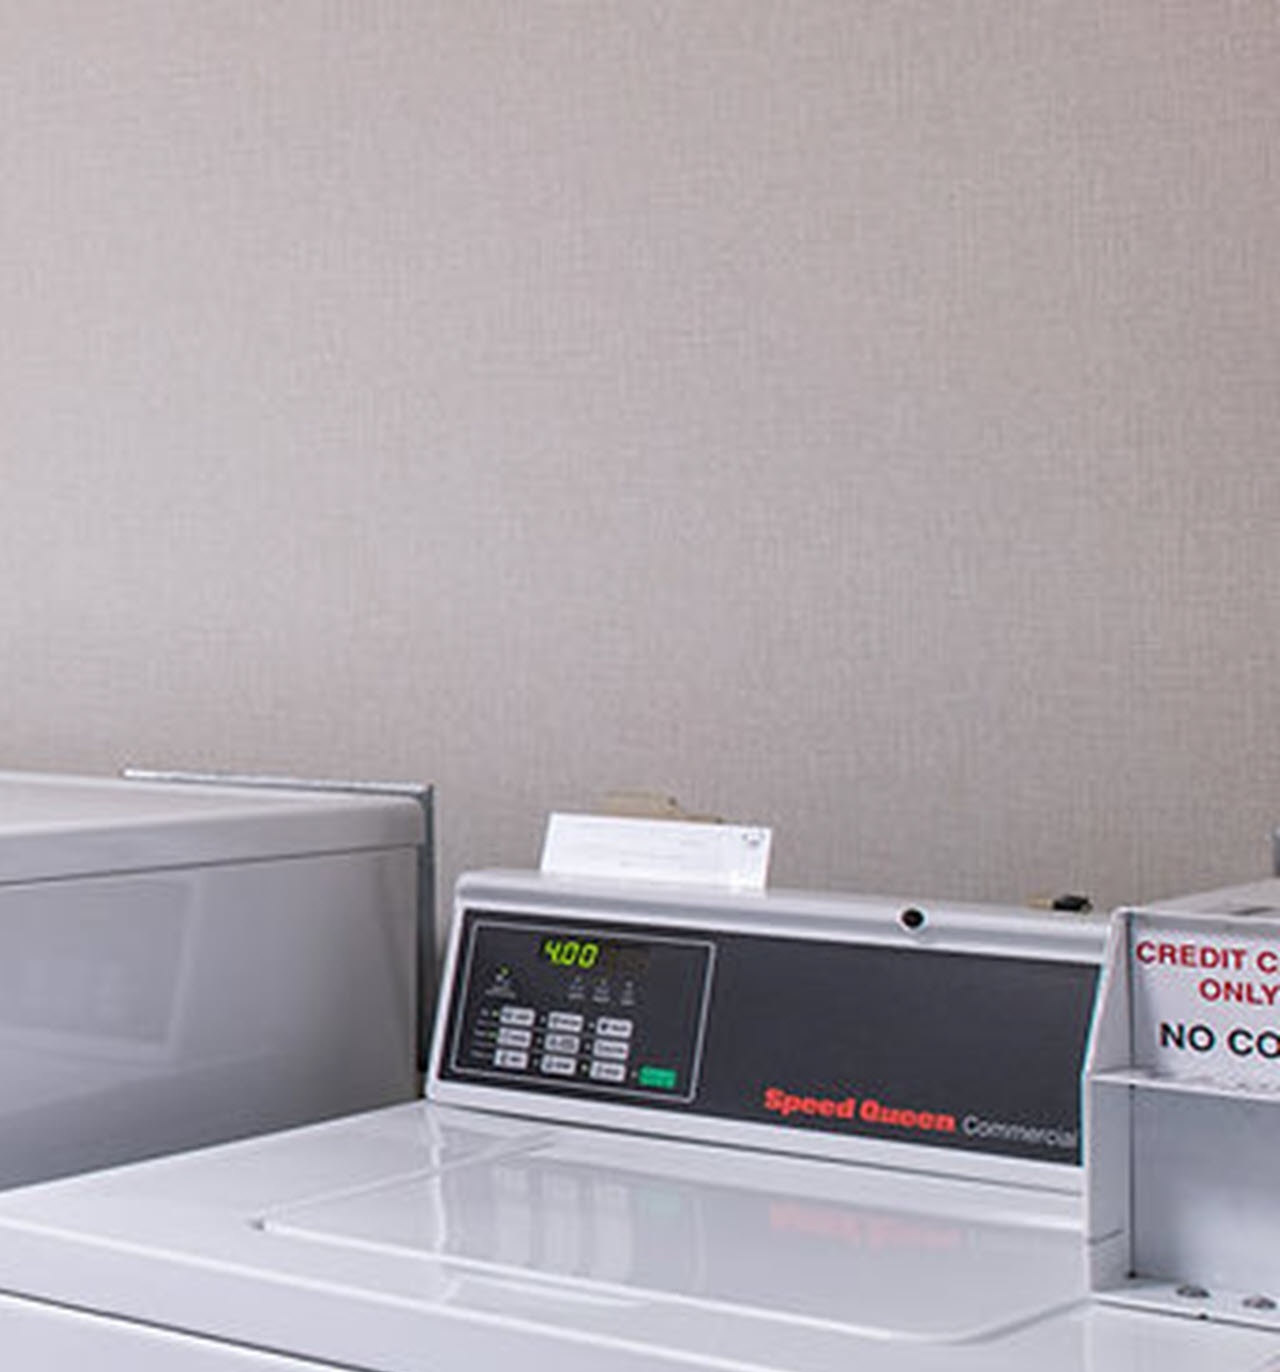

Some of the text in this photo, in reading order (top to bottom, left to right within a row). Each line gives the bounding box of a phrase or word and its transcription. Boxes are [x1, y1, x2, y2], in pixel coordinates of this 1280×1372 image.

[1136, 940, 1247, 971] CREDIT
[1198, 978, 1280, 1006] ONLY
[1160, 1021, 1216, 1052] NO
[764, 1086, 1077, 1149] Speed Queen Commercial
